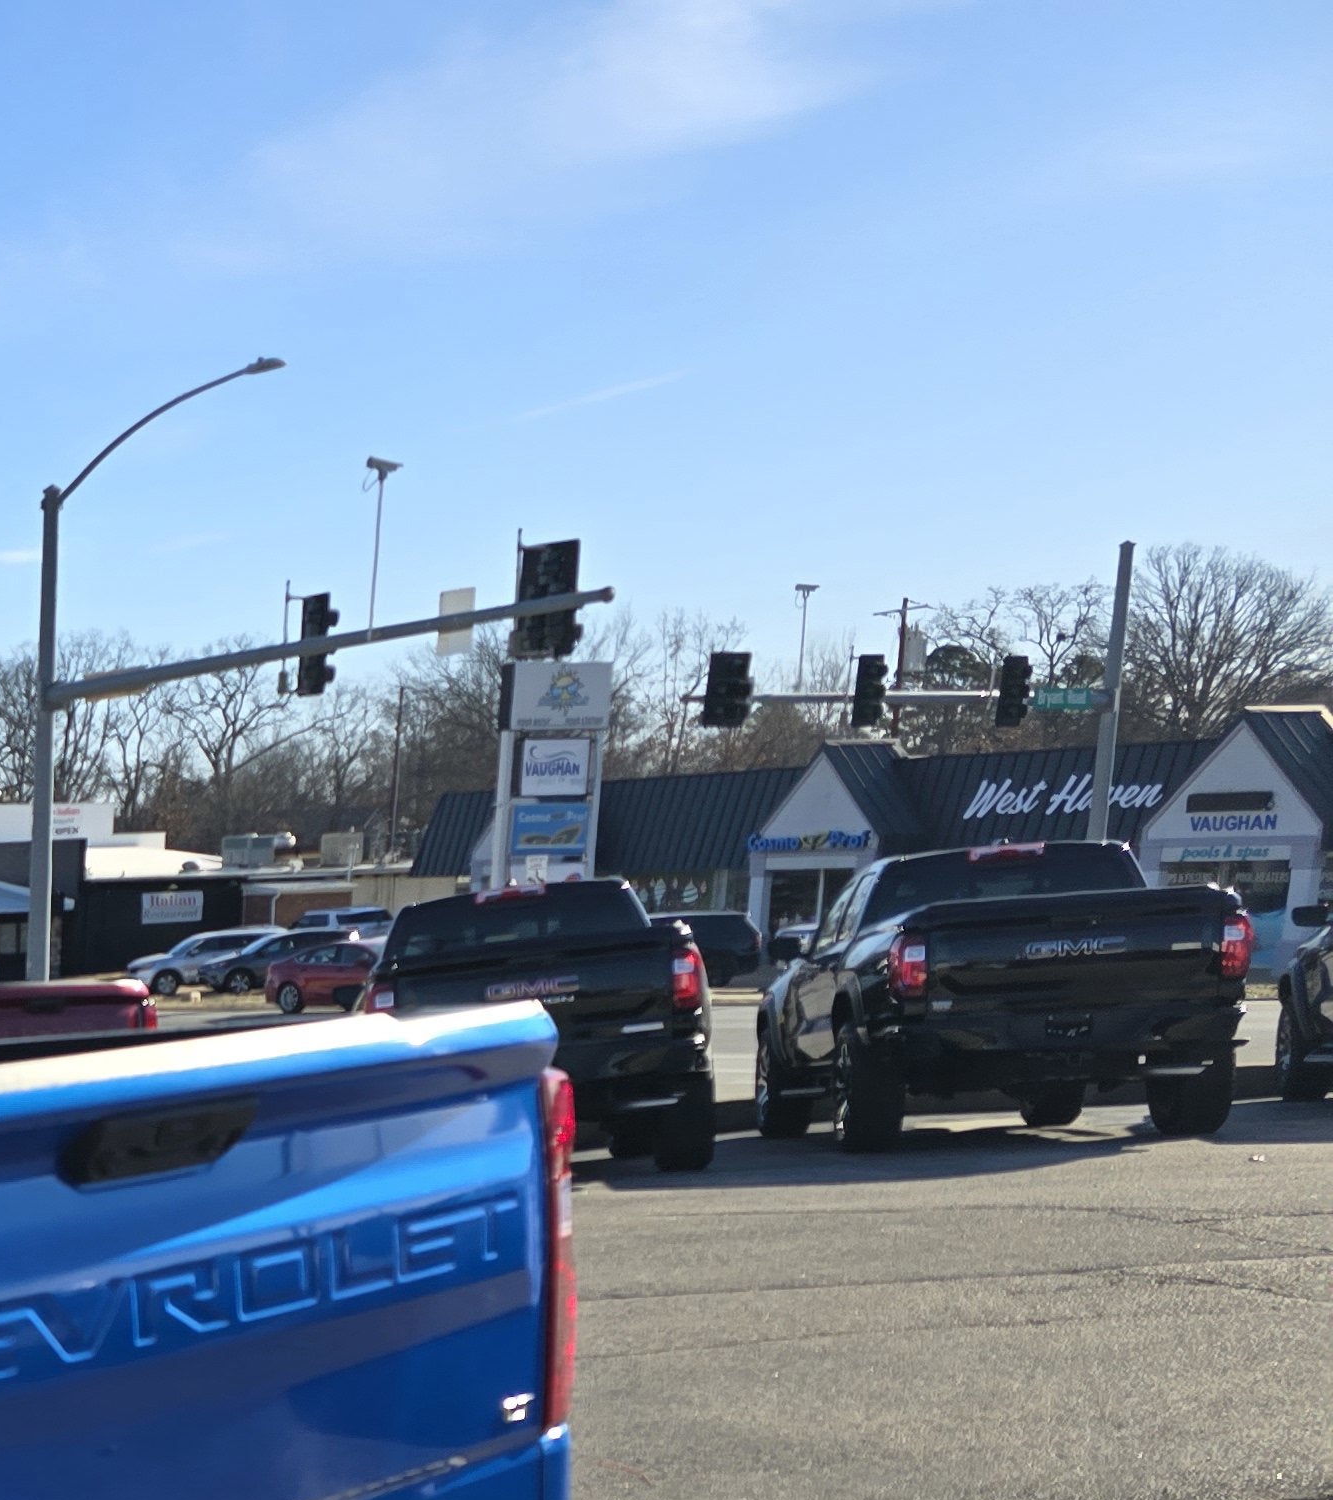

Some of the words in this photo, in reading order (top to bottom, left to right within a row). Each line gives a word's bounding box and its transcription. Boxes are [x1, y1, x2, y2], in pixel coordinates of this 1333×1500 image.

[524, 760, 581, 777] VAUGHAN
[962, 777, 1048, 821] West
[1189, 813, 1278, 832] VAUGHAN
[747, 833, 800, 852] Cosmo
[829, 830, 872, 849] Prof
[1179, 846, 1220, 862] pools
[1236, 846, 1270, 860] spas
[149, 894, 198, 908] Italian
[1025, 936, 1127, 960] GMC
[484, 975, 580, 1001] GMC
